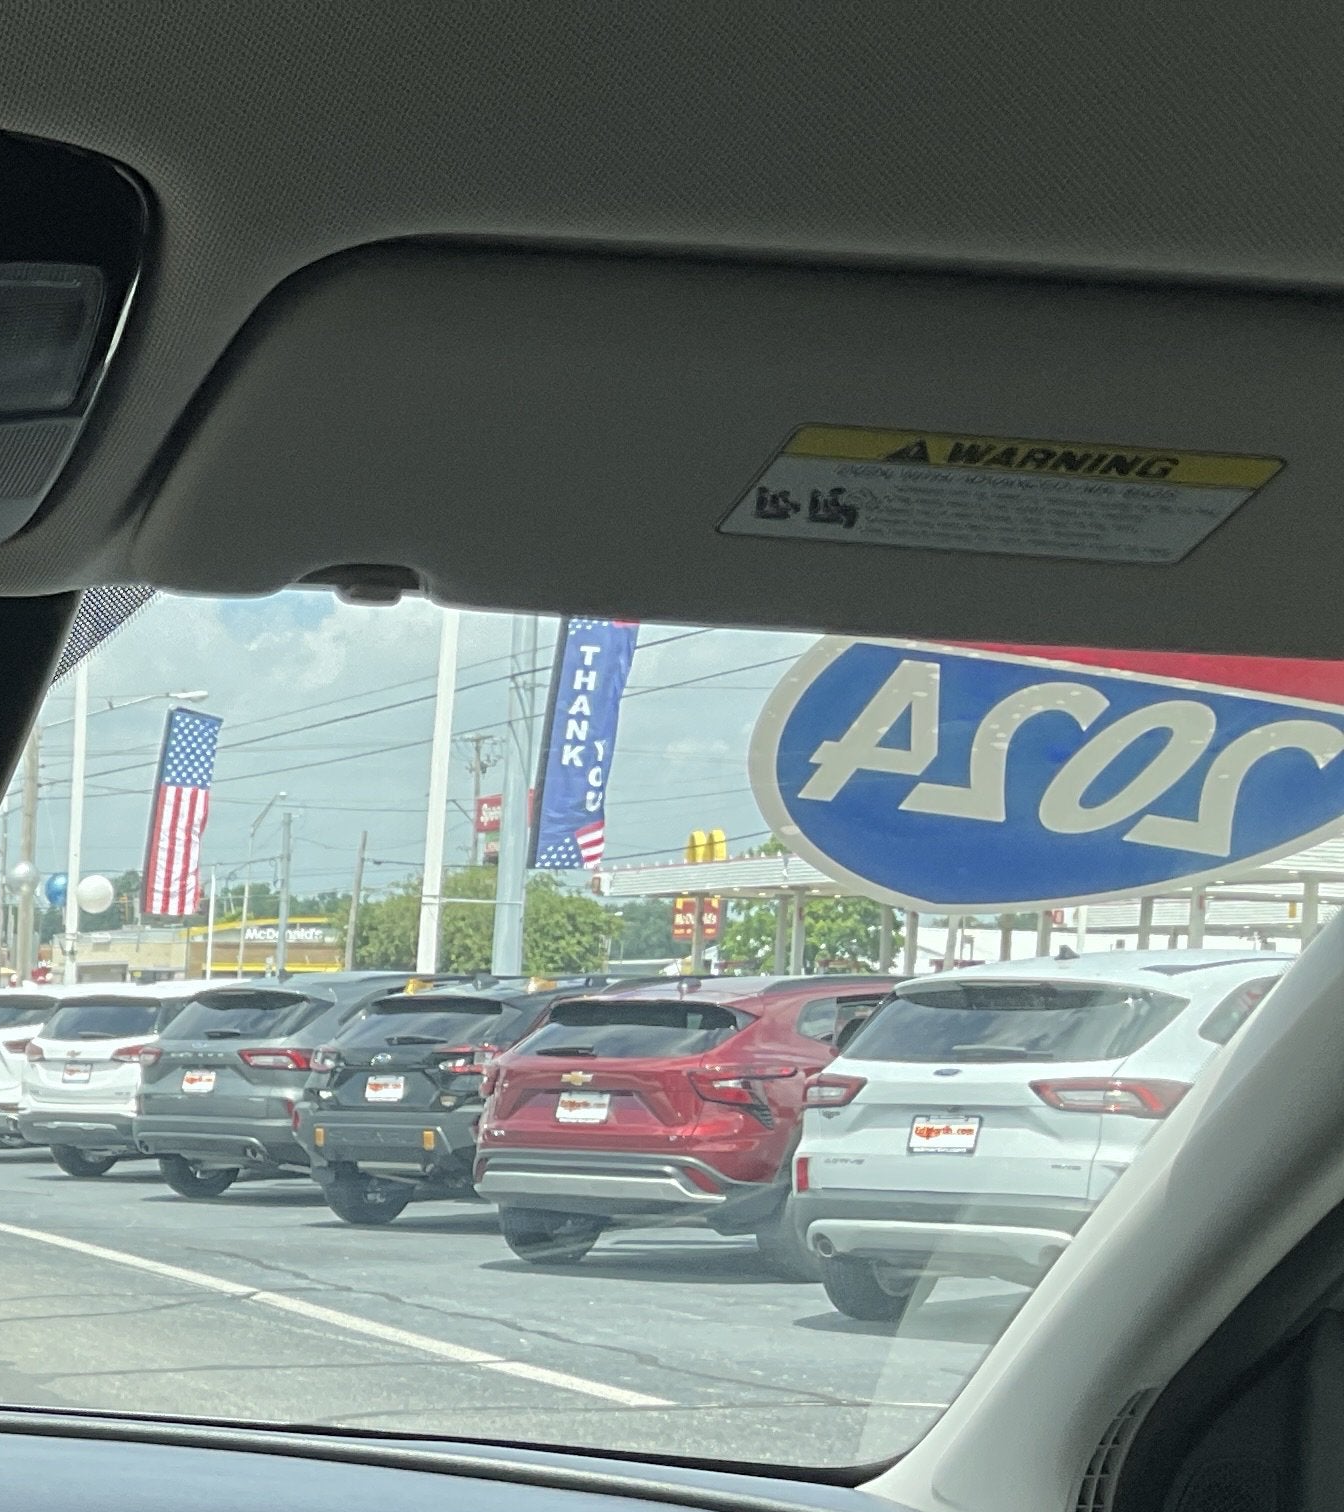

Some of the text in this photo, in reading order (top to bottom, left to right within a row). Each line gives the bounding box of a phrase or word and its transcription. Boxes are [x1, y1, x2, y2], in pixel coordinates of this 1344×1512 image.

[947, 442, 1179, 479] WARNING
[561, 644, 601, 767] THANK
[584, 738, 607, 812] YOU
